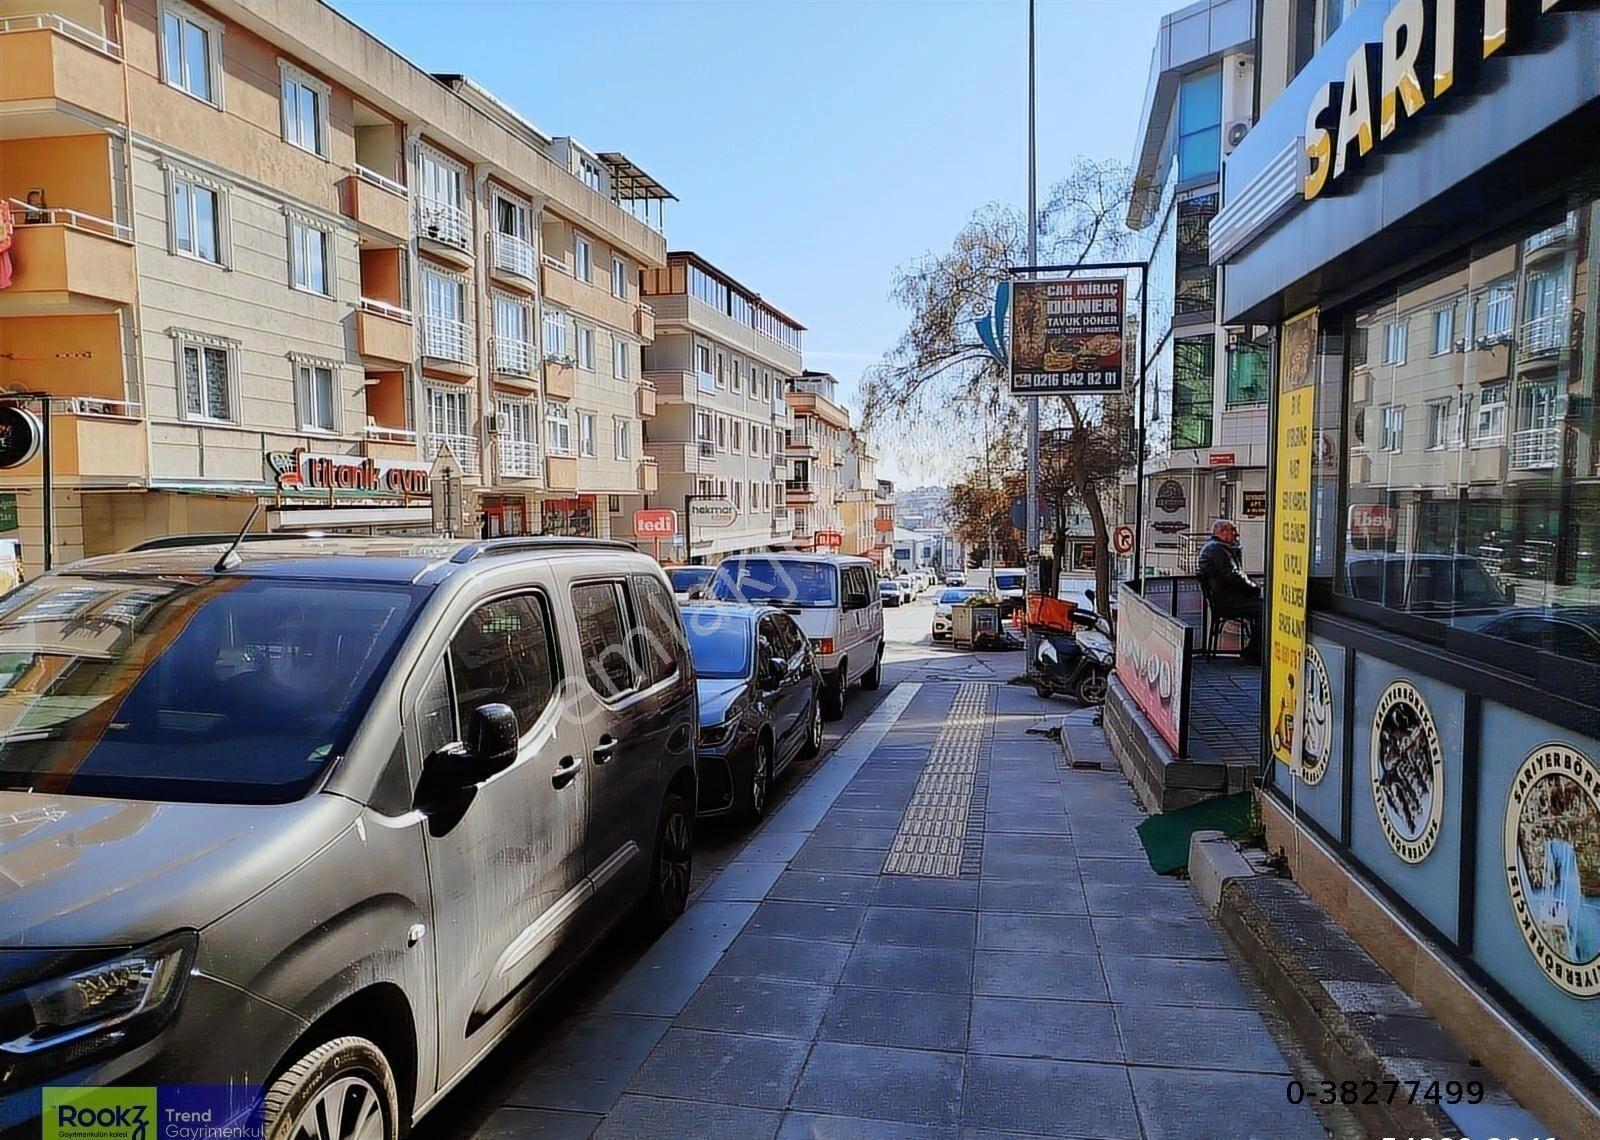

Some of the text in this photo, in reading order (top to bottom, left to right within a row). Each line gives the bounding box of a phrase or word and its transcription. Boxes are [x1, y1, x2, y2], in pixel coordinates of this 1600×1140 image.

[1047, 284, 1073, 296] CAN
[1047, 297, 1117, 314] DÖNER
[1047, 317, 1080, 327] TAVUK
[1033, 373, 1059, 387] 0216
[1062, 372, 1084, 386] 642
[1105, 371, 1116, 385] 01
